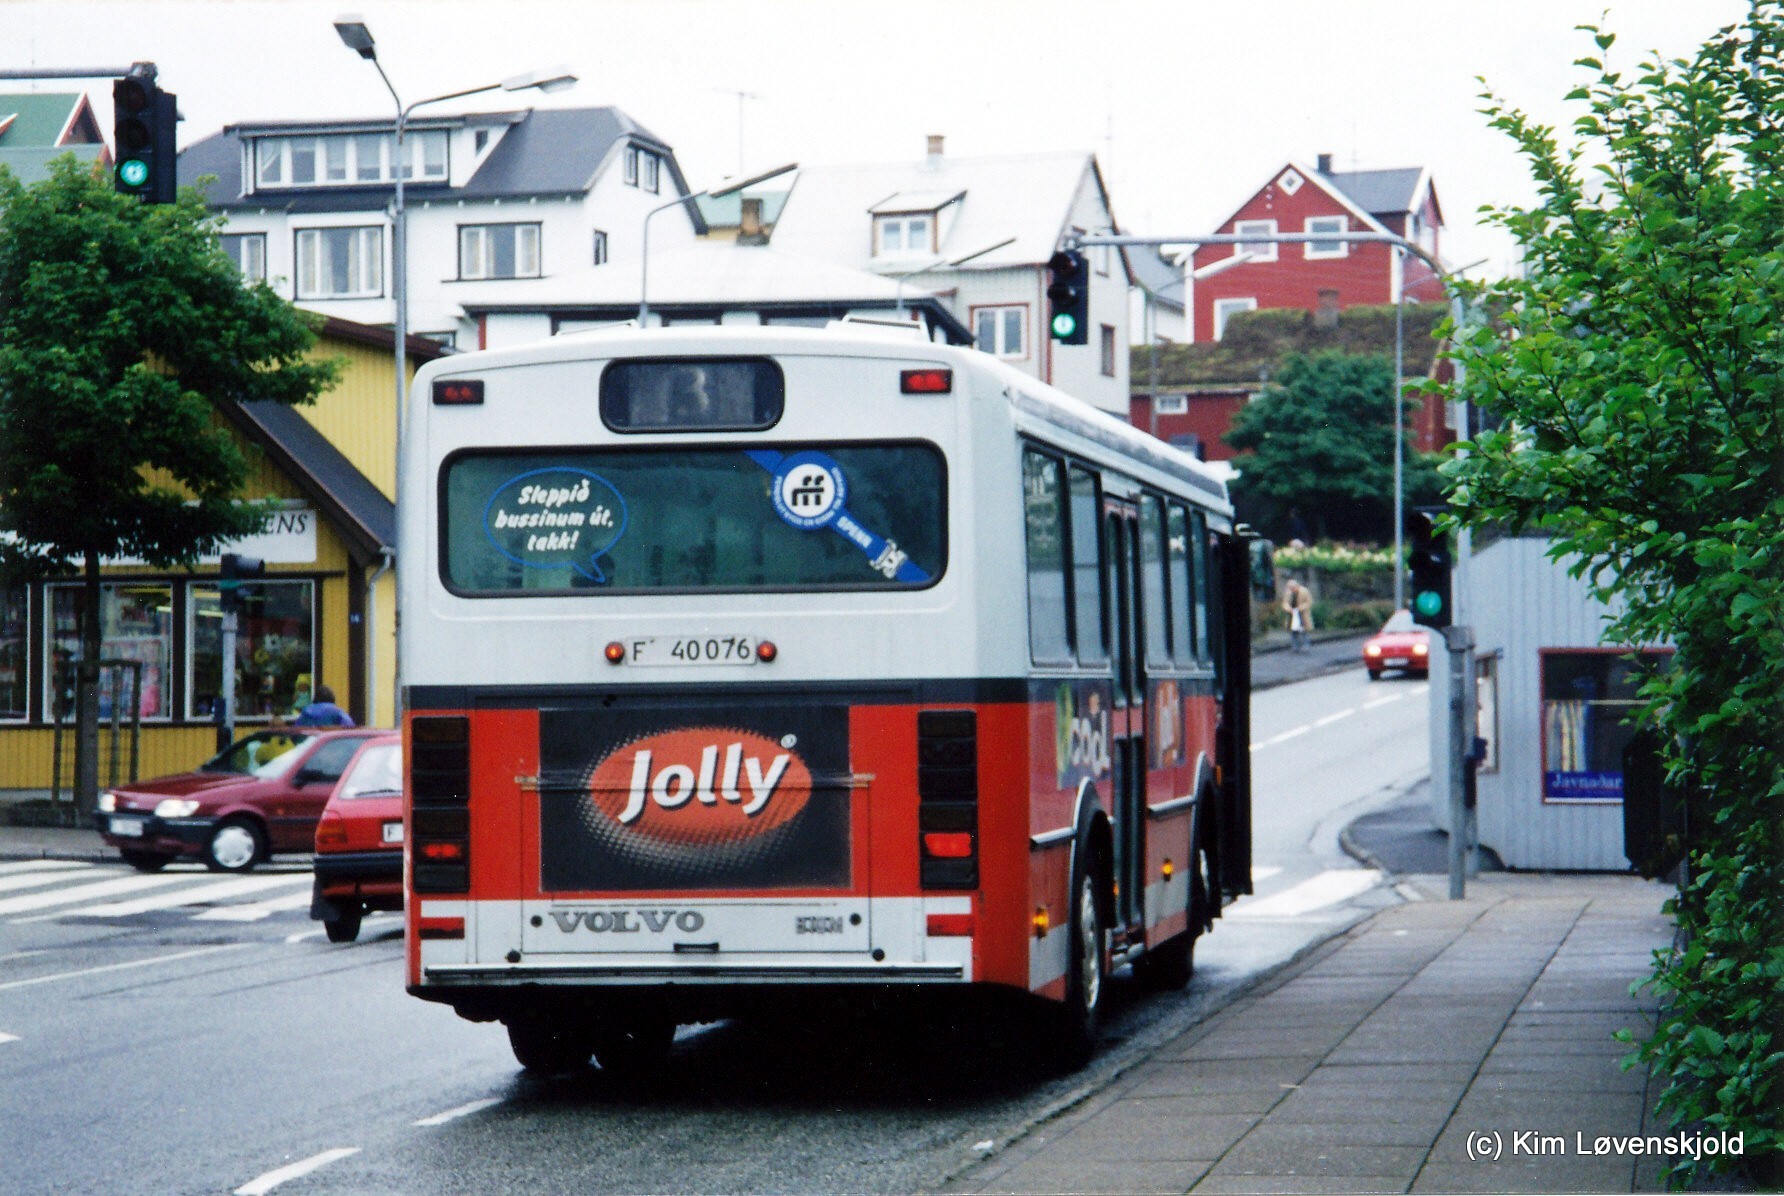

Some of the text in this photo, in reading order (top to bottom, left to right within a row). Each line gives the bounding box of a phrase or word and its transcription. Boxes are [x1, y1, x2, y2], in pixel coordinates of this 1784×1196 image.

[517, 478, 590, 508] Sleppið
[494, 509, 585, 529] bussinum
[527, 530, 580, 551] takk!
[633, 641, 646, 661] F
[617, 742, 791, 825] Jolly
[549, 910, 705, 933] VOLVO
